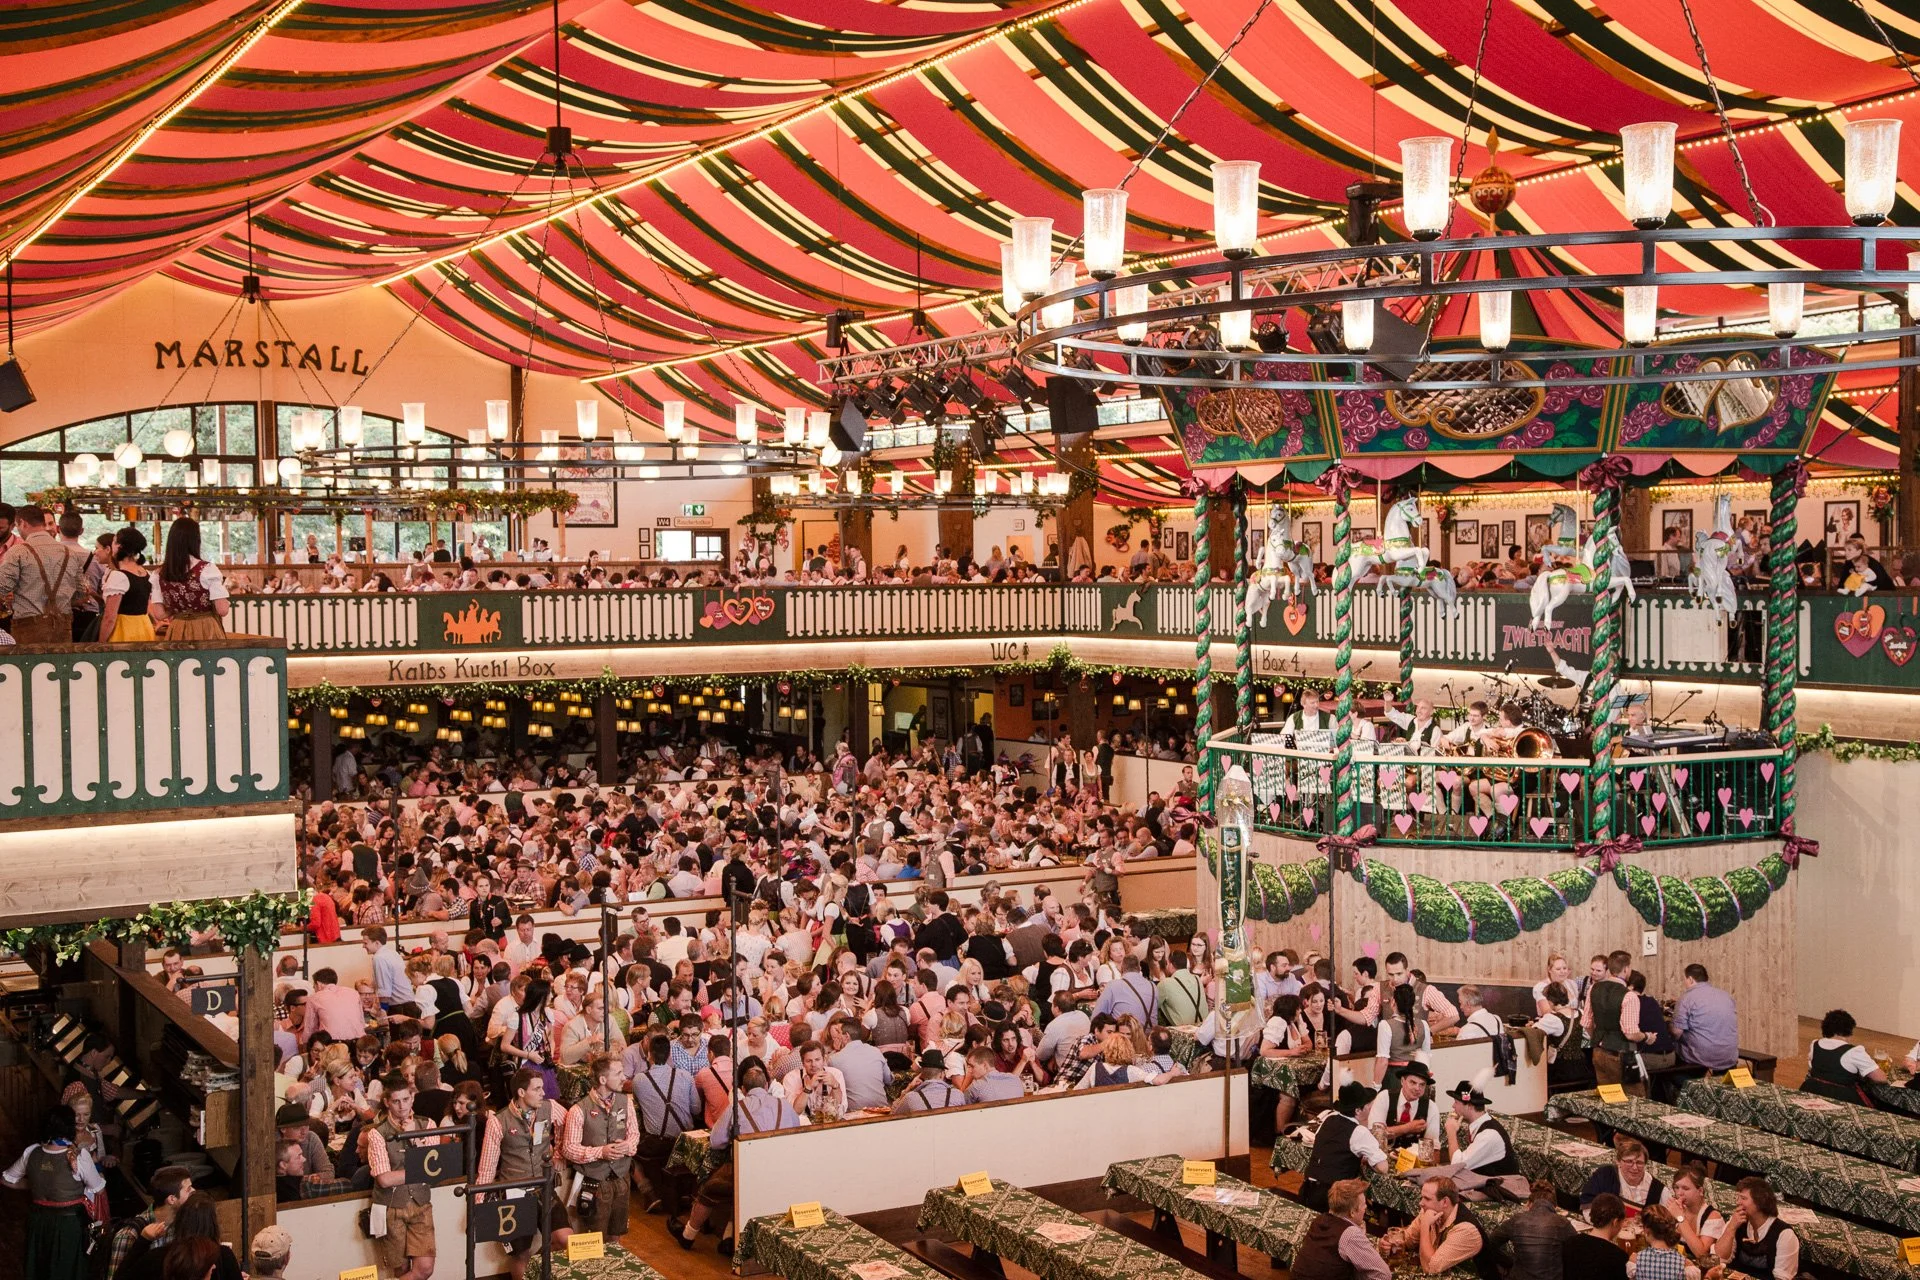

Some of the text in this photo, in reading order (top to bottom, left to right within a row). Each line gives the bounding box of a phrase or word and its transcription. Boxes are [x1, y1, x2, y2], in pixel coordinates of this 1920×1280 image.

[155, 340, 369, 376] MARSTALL
[657, 518, 670, 526] W4
[991, 642, 1019, 661] WC
[1262, 650, 1301, 673] Box 4
[388, 655, 556, 682] Kalbs Kuchl Box
[206, 990, 222, 1011] D
[423, 1149, 442, 1177] C
[497, 1204, 517, 1236] B
[571, 1239, 600, 1247] Reserviert
